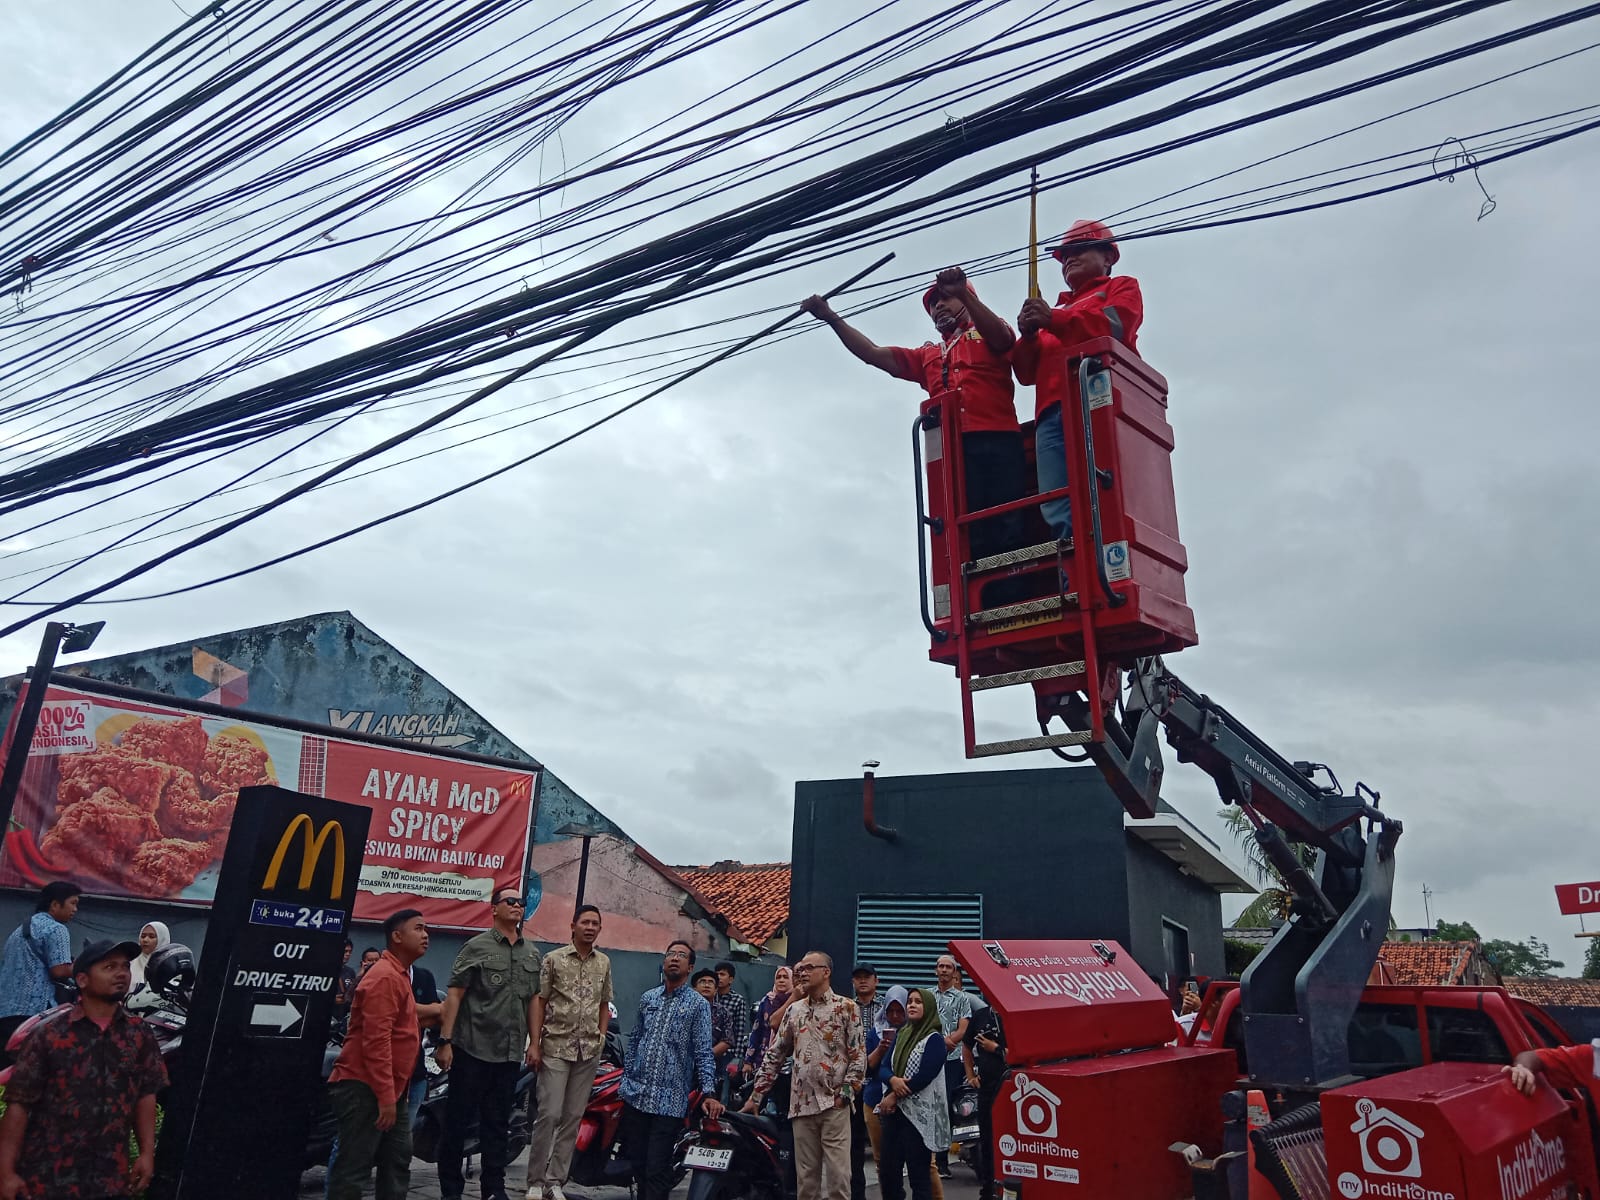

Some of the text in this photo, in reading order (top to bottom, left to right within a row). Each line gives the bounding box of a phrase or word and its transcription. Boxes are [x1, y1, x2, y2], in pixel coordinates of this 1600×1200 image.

[40, 706, 85, 725] 00%
[34, 724, 62, 738] ASLI
[32, 736, 88, 749] INDONESIA
[1244, 753, 1286, 792] Aerial Platform
[361, 768, 500, 815] AYAM McD
[388, 807, 467, 845] SPICY
[404, 845, 438, 862] BIKIN
[441, 849, 475, 867] BALIK
[478, 853, 505, 869] LAGI
[381, 870, 462, 886] 9/10 KONSUMEN SETUJU
[392, 882, 424, 891] MERESAP
[424, 885, 448, 894] HINGGA
[457, 888, 482, 897] DAGING
[273, 907, 341, 928] buka 24 jam
[273, 942, 310, 960] OUT
[233, 970, 334, 992] DRIVE-THRU
[1016, 970, 1142, 1006] IndiHome
[1001, 1139, 1079, 1159] my IndiHome
[1496, 1127, 1566, 1200] IndiHome
[1341, 1178, 1455, 1200] my IndiHome
